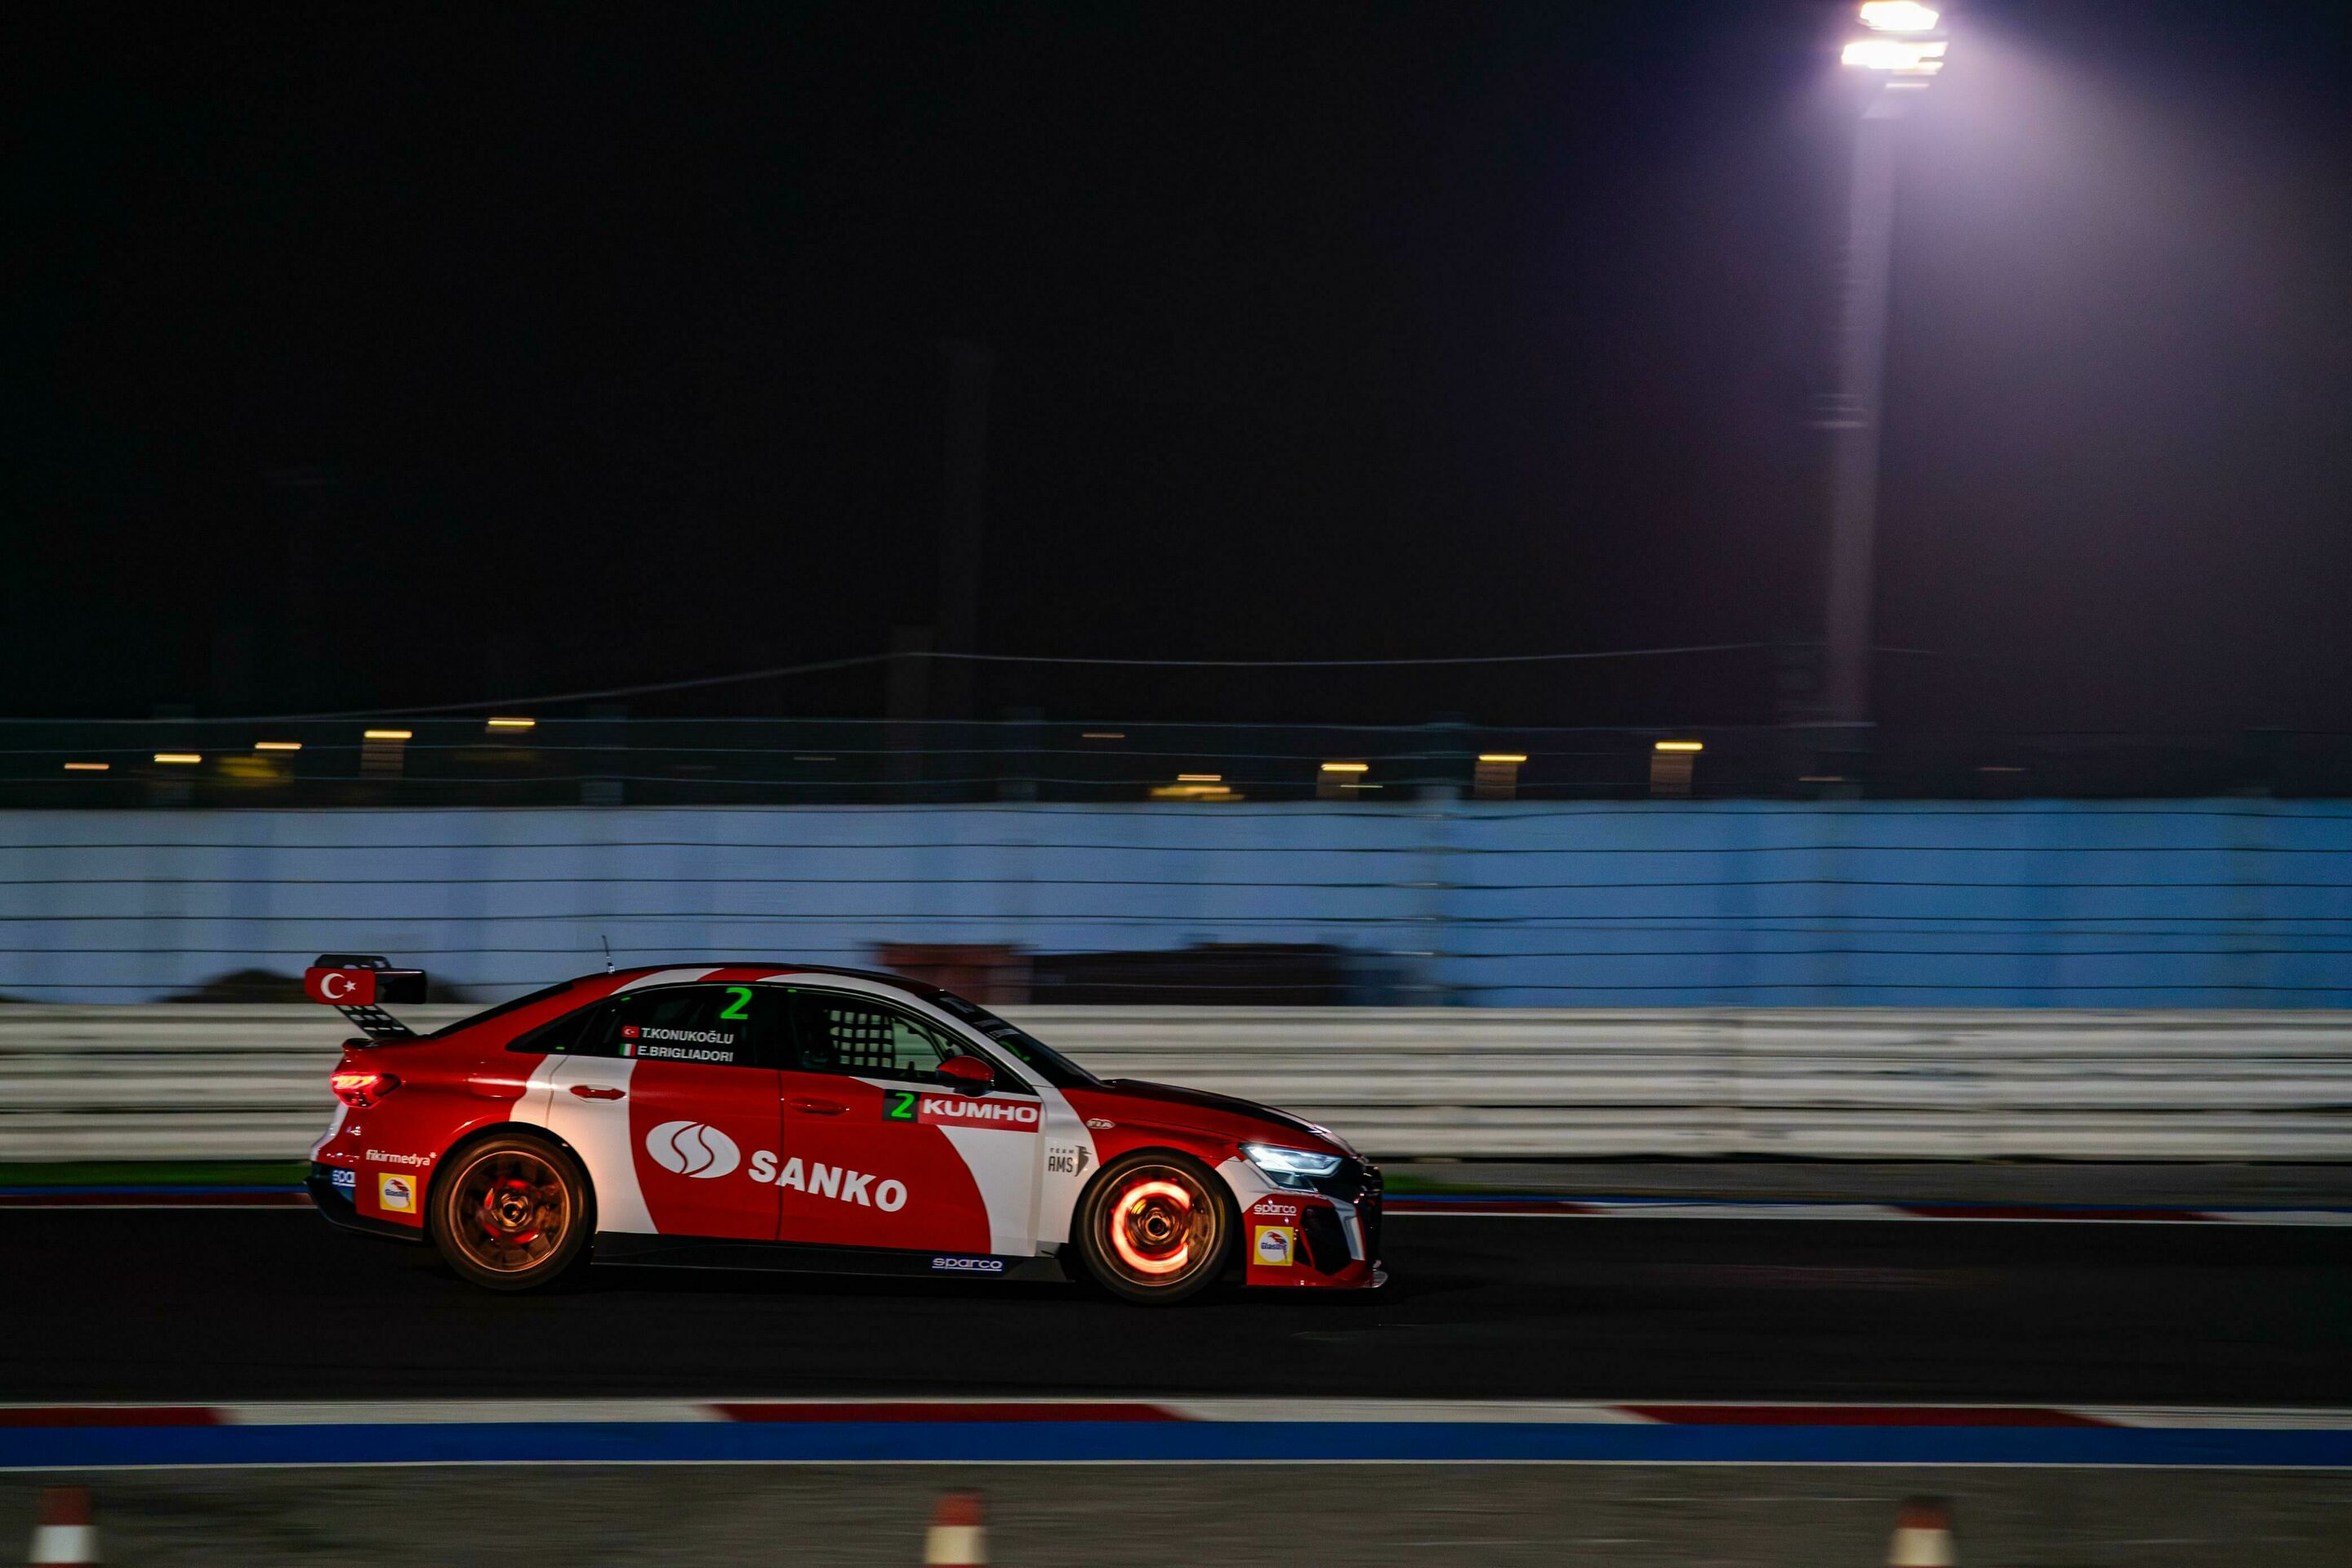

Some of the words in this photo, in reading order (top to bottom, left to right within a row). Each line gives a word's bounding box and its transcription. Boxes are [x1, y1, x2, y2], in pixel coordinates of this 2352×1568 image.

[719, 987, 753, 1020] 2
[640, 1027, 735, 1045] T.KONUKOĞLU
[636, 1045, 734, 1062] E.BRIGLIADORI
[890, 1093, 915, 1119] 2
[922, 1098, 1039, 1125] KUMHO
[1089, 1120, 1113, 1129] FIA
[1048, 1156, 1074, 1174] AMS
[747, 1150, 908, 1213] SANKO
[1254, 1204, 1298, 1216] sparco
[932, 1257, 1004, 1272] sparco
